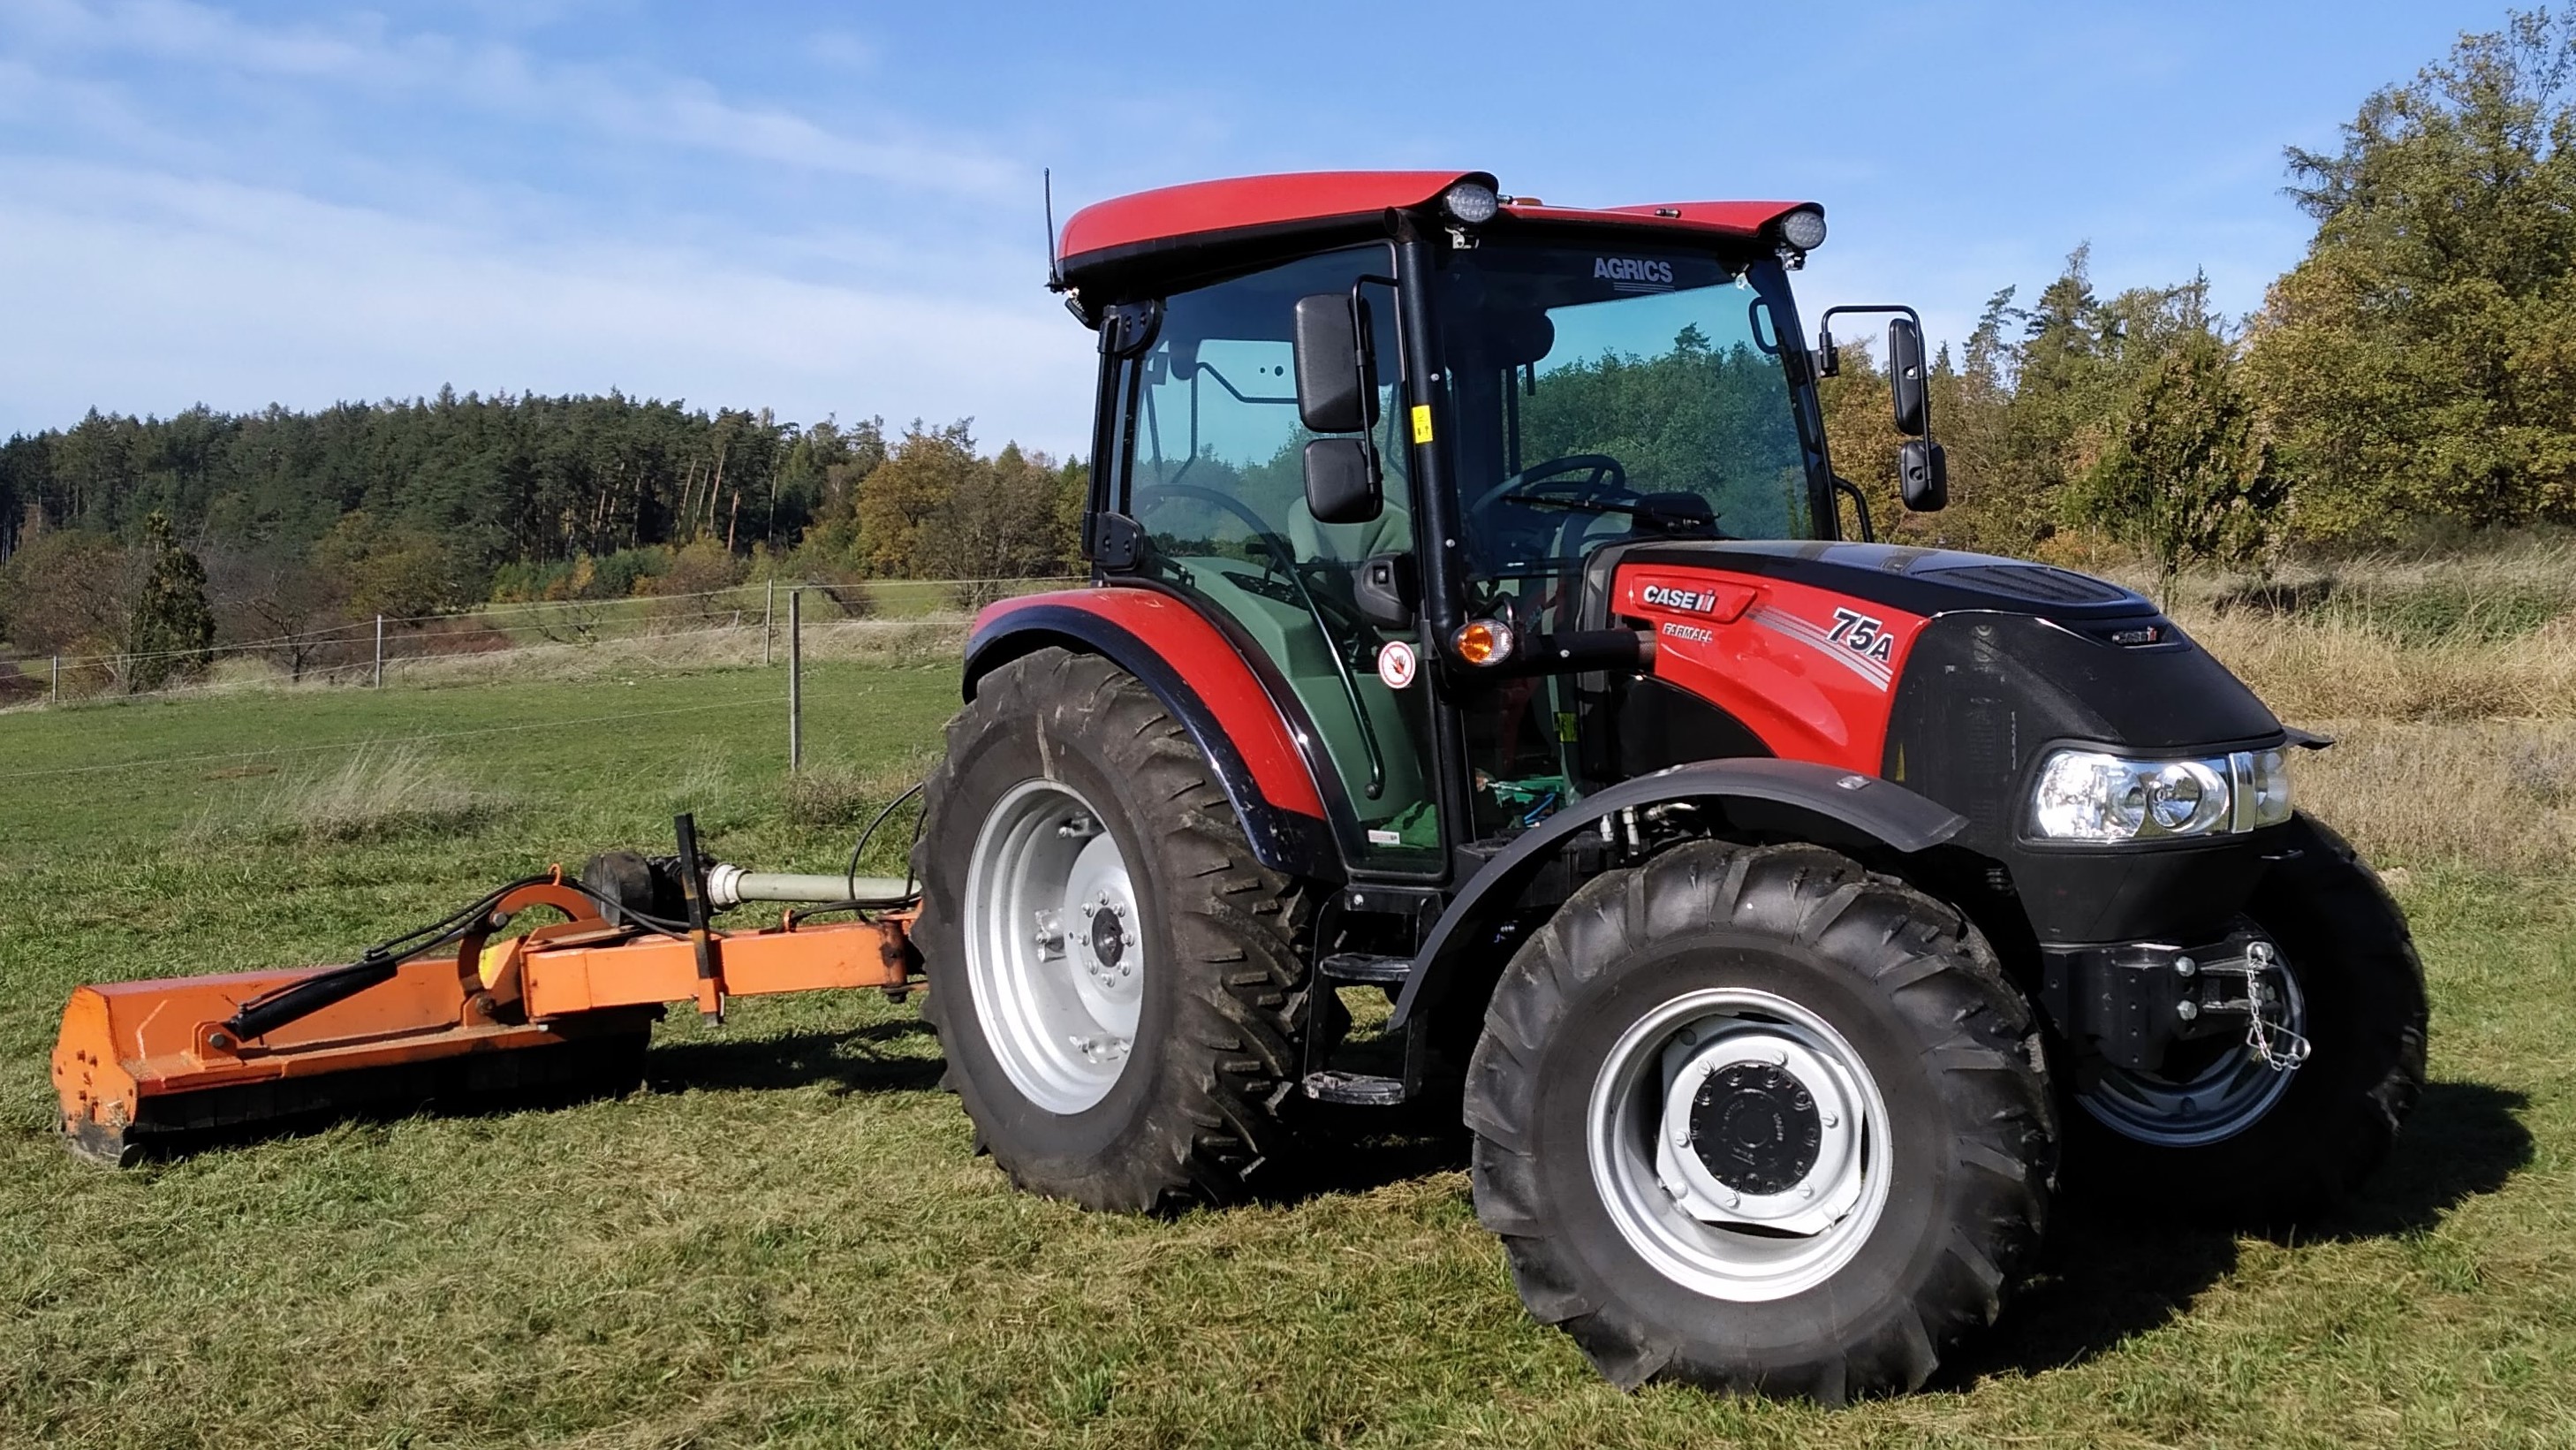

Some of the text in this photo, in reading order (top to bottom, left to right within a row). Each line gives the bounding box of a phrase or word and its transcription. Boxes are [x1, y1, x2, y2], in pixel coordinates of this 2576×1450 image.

[1594, 257, 1673, 283] AGRICS
[1643, 585, 1696, 610] CASE
[1663, 622, 1713, 643] FARMALL
[1826, 606, 1894, 664] 75A
